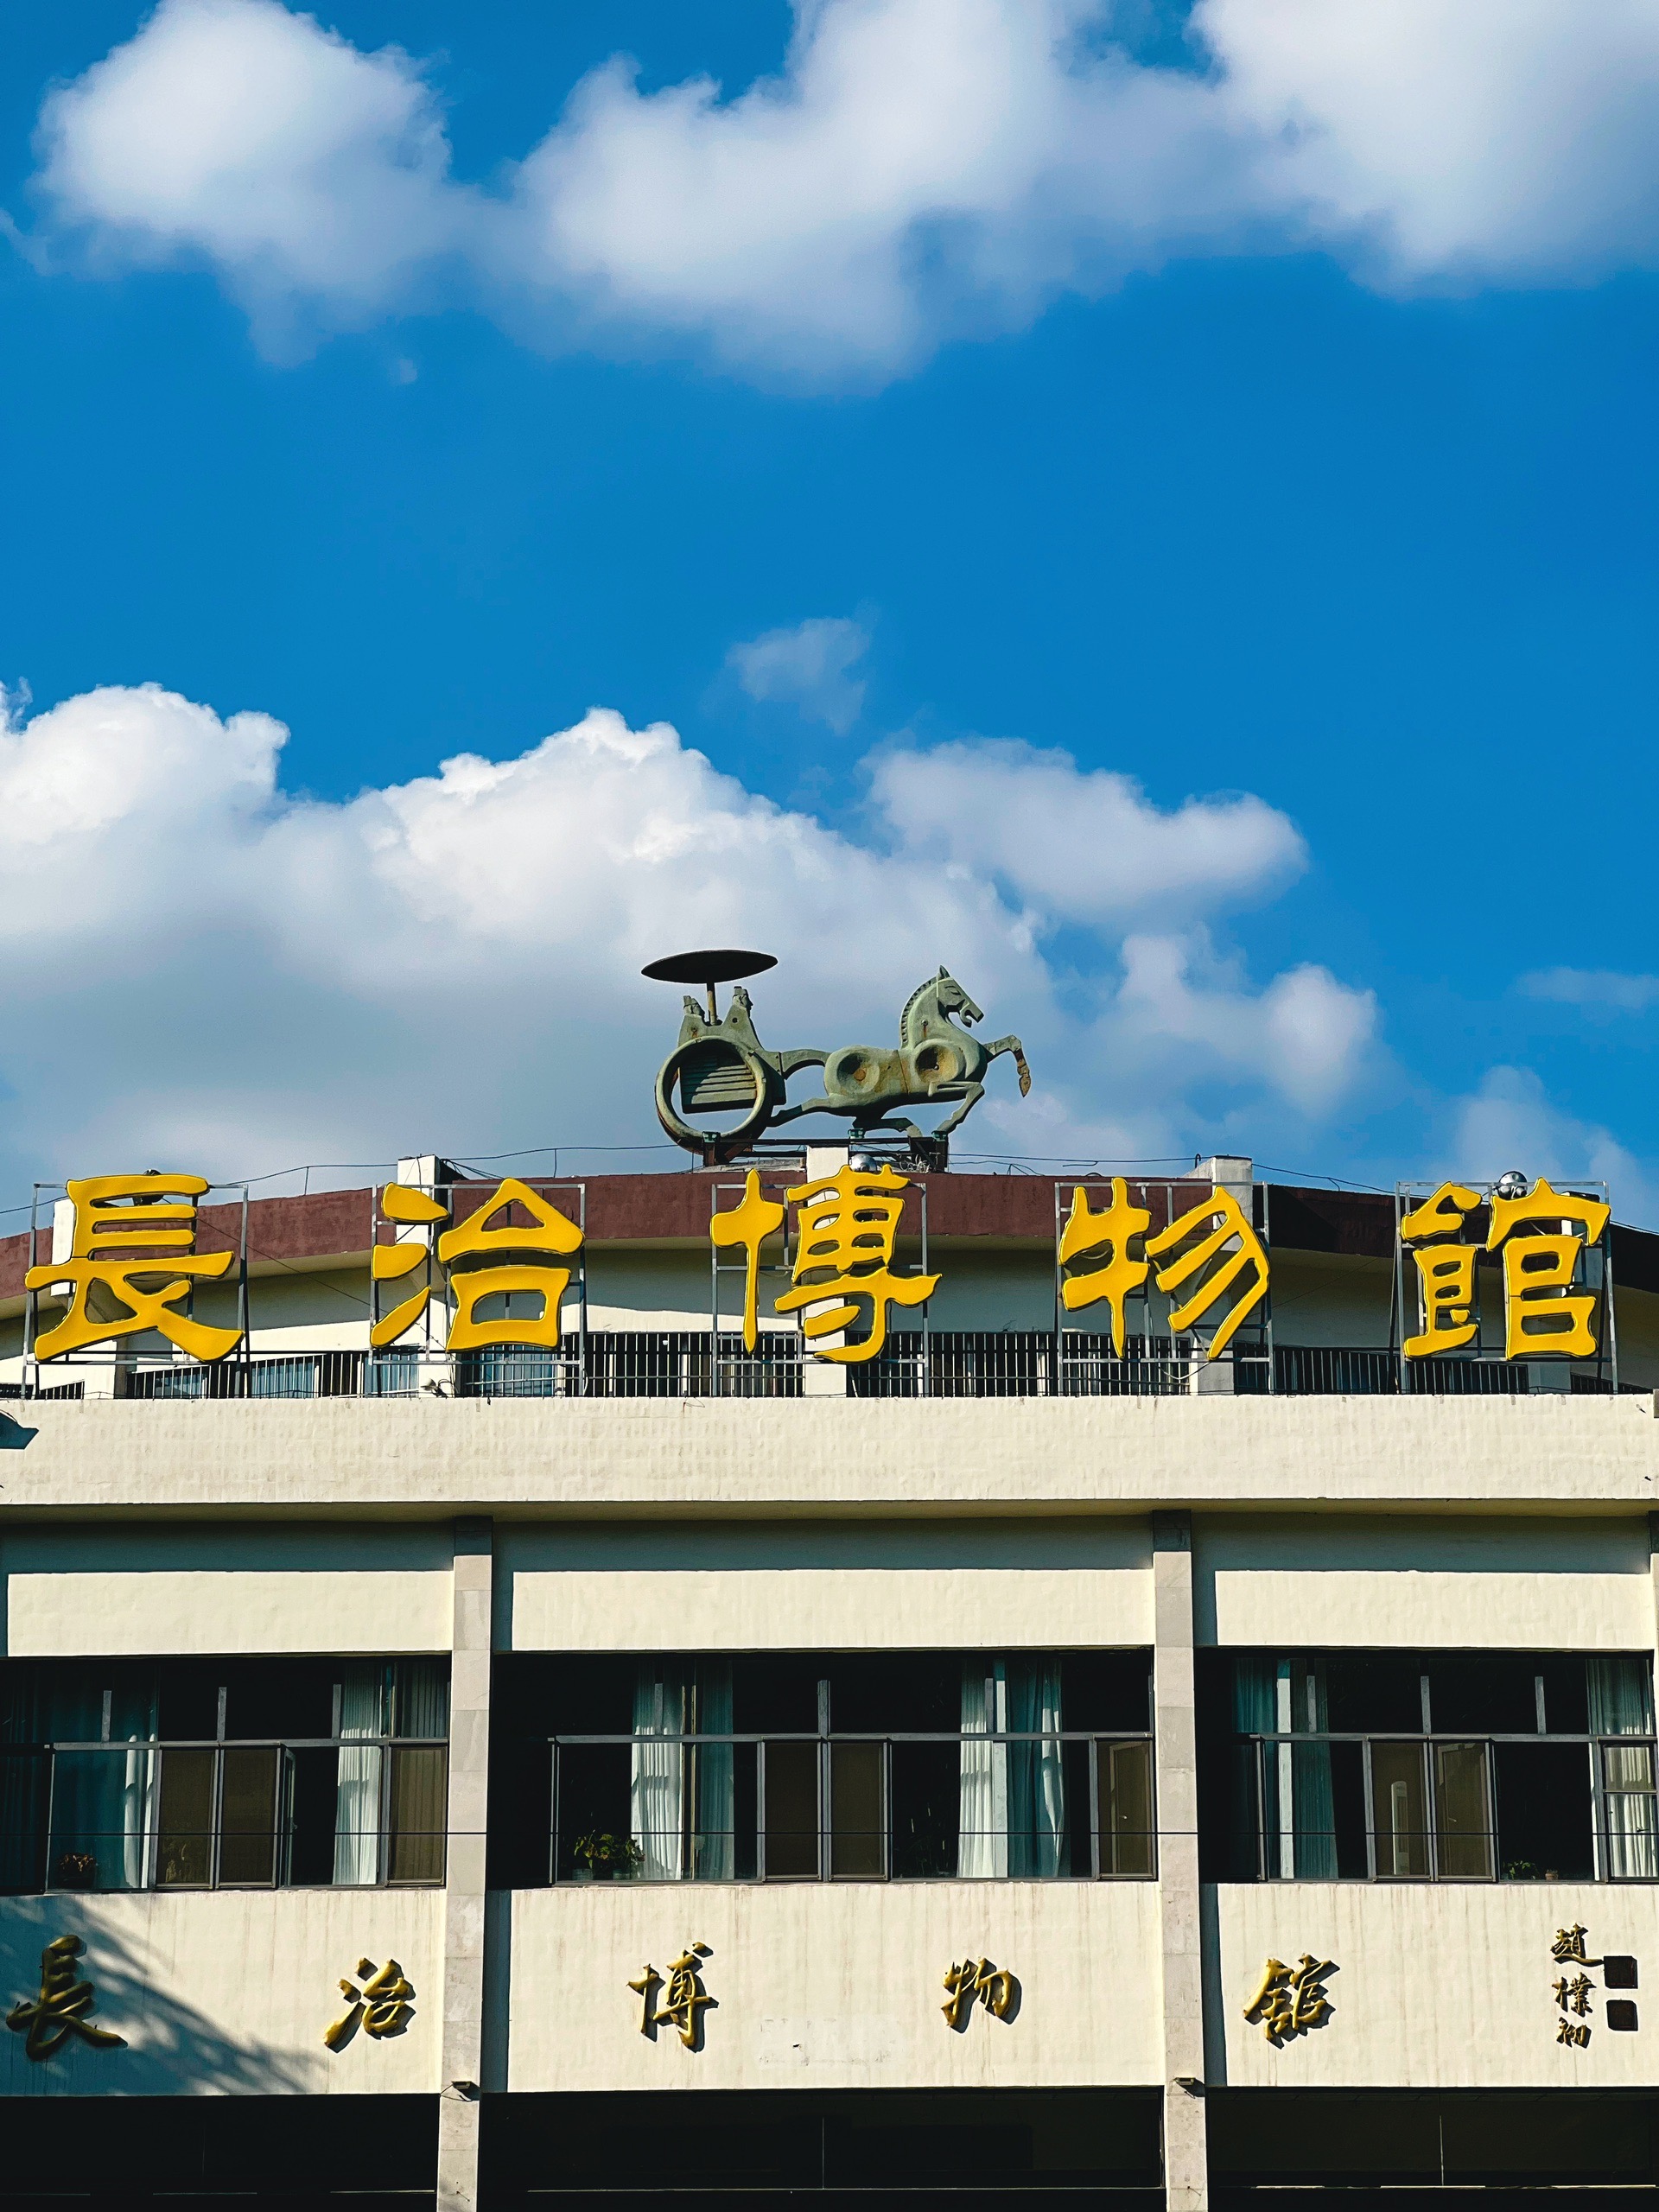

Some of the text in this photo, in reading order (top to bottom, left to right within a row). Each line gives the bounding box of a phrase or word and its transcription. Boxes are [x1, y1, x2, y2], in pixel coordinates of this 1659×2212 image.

[24, 1164, 1611, 1363] 長治博物館
